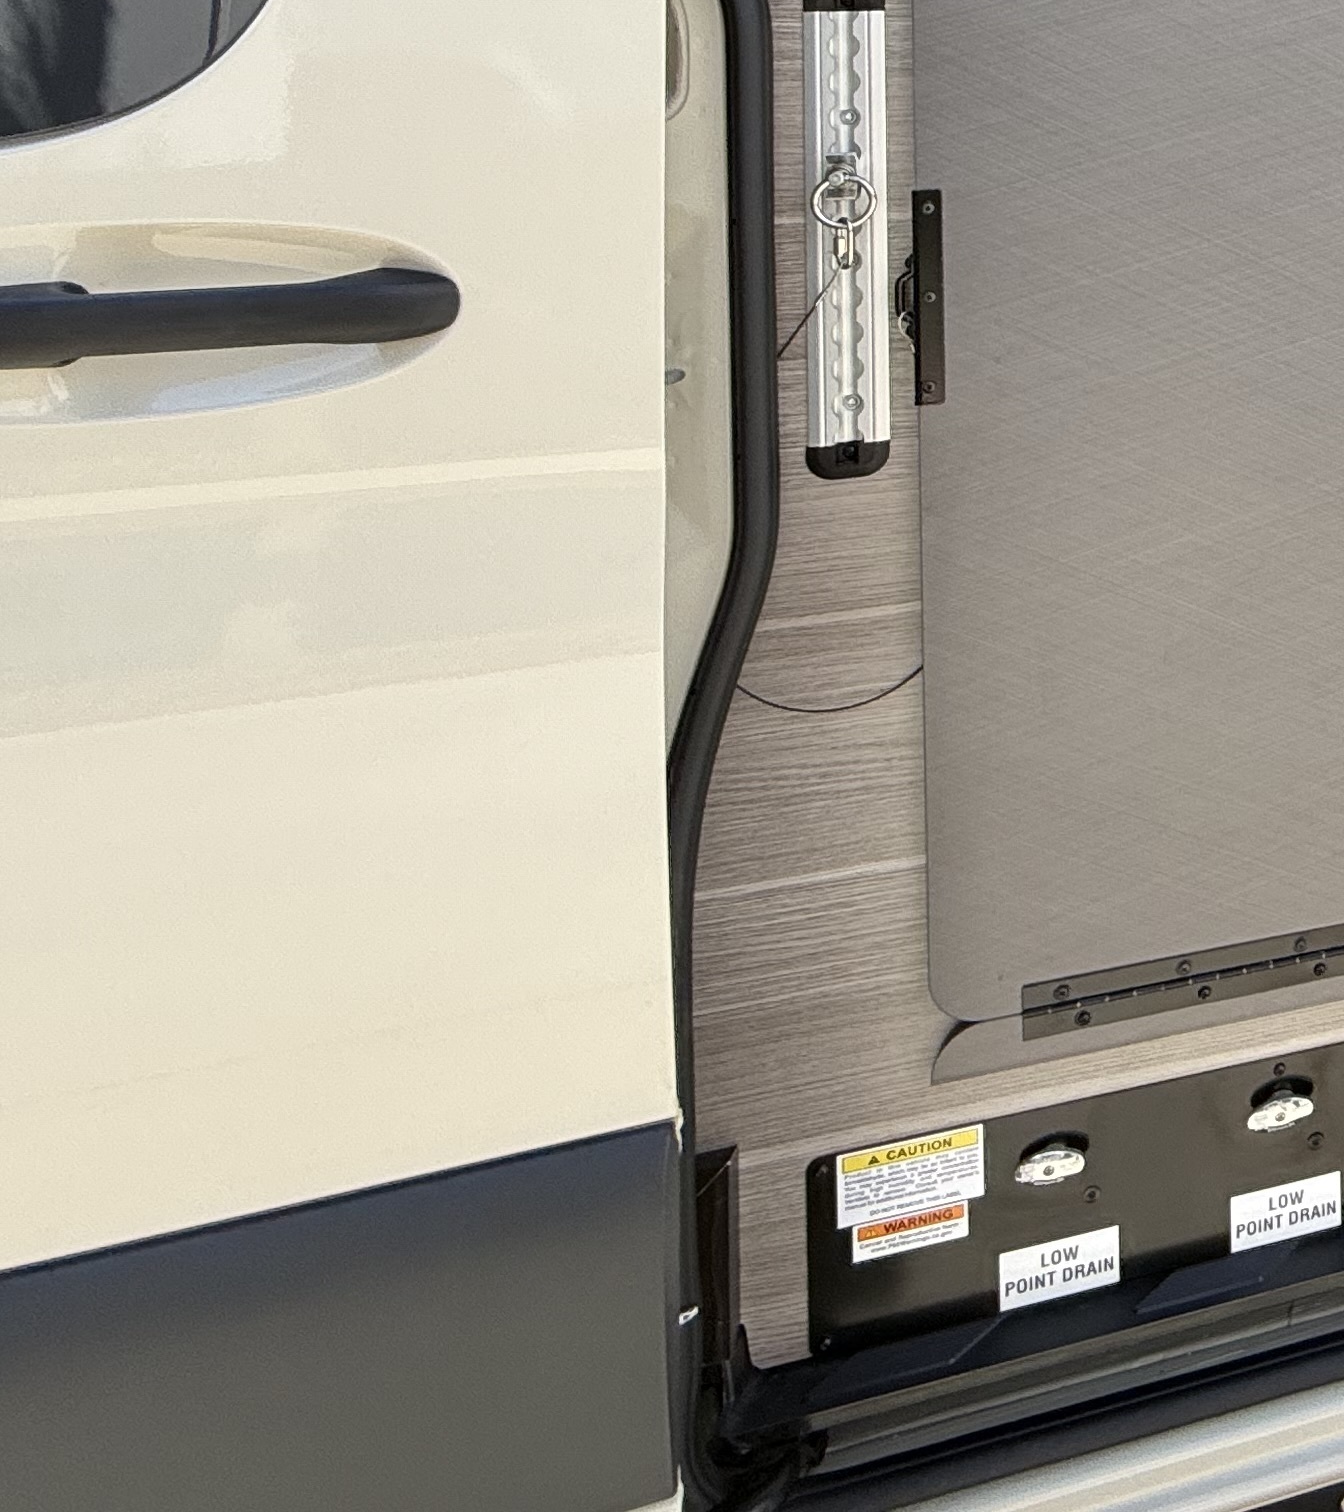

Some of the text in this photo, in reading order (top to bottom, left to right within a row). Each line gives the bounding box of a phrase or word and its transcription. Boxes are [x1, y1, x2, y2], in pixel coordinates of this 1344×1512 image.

[886, 1137, 952, 1161] CAUTION
[1268, 1189, 1304, 1211] LOW
[883, 1209, 954, 1234] WARNING
[1236, 1200, 1337, 1239] POINT DRAIN
[1040, 1245, 1079, 1268] LOW
[1004, 1255, 1114, 1298] POINT DRAIN
